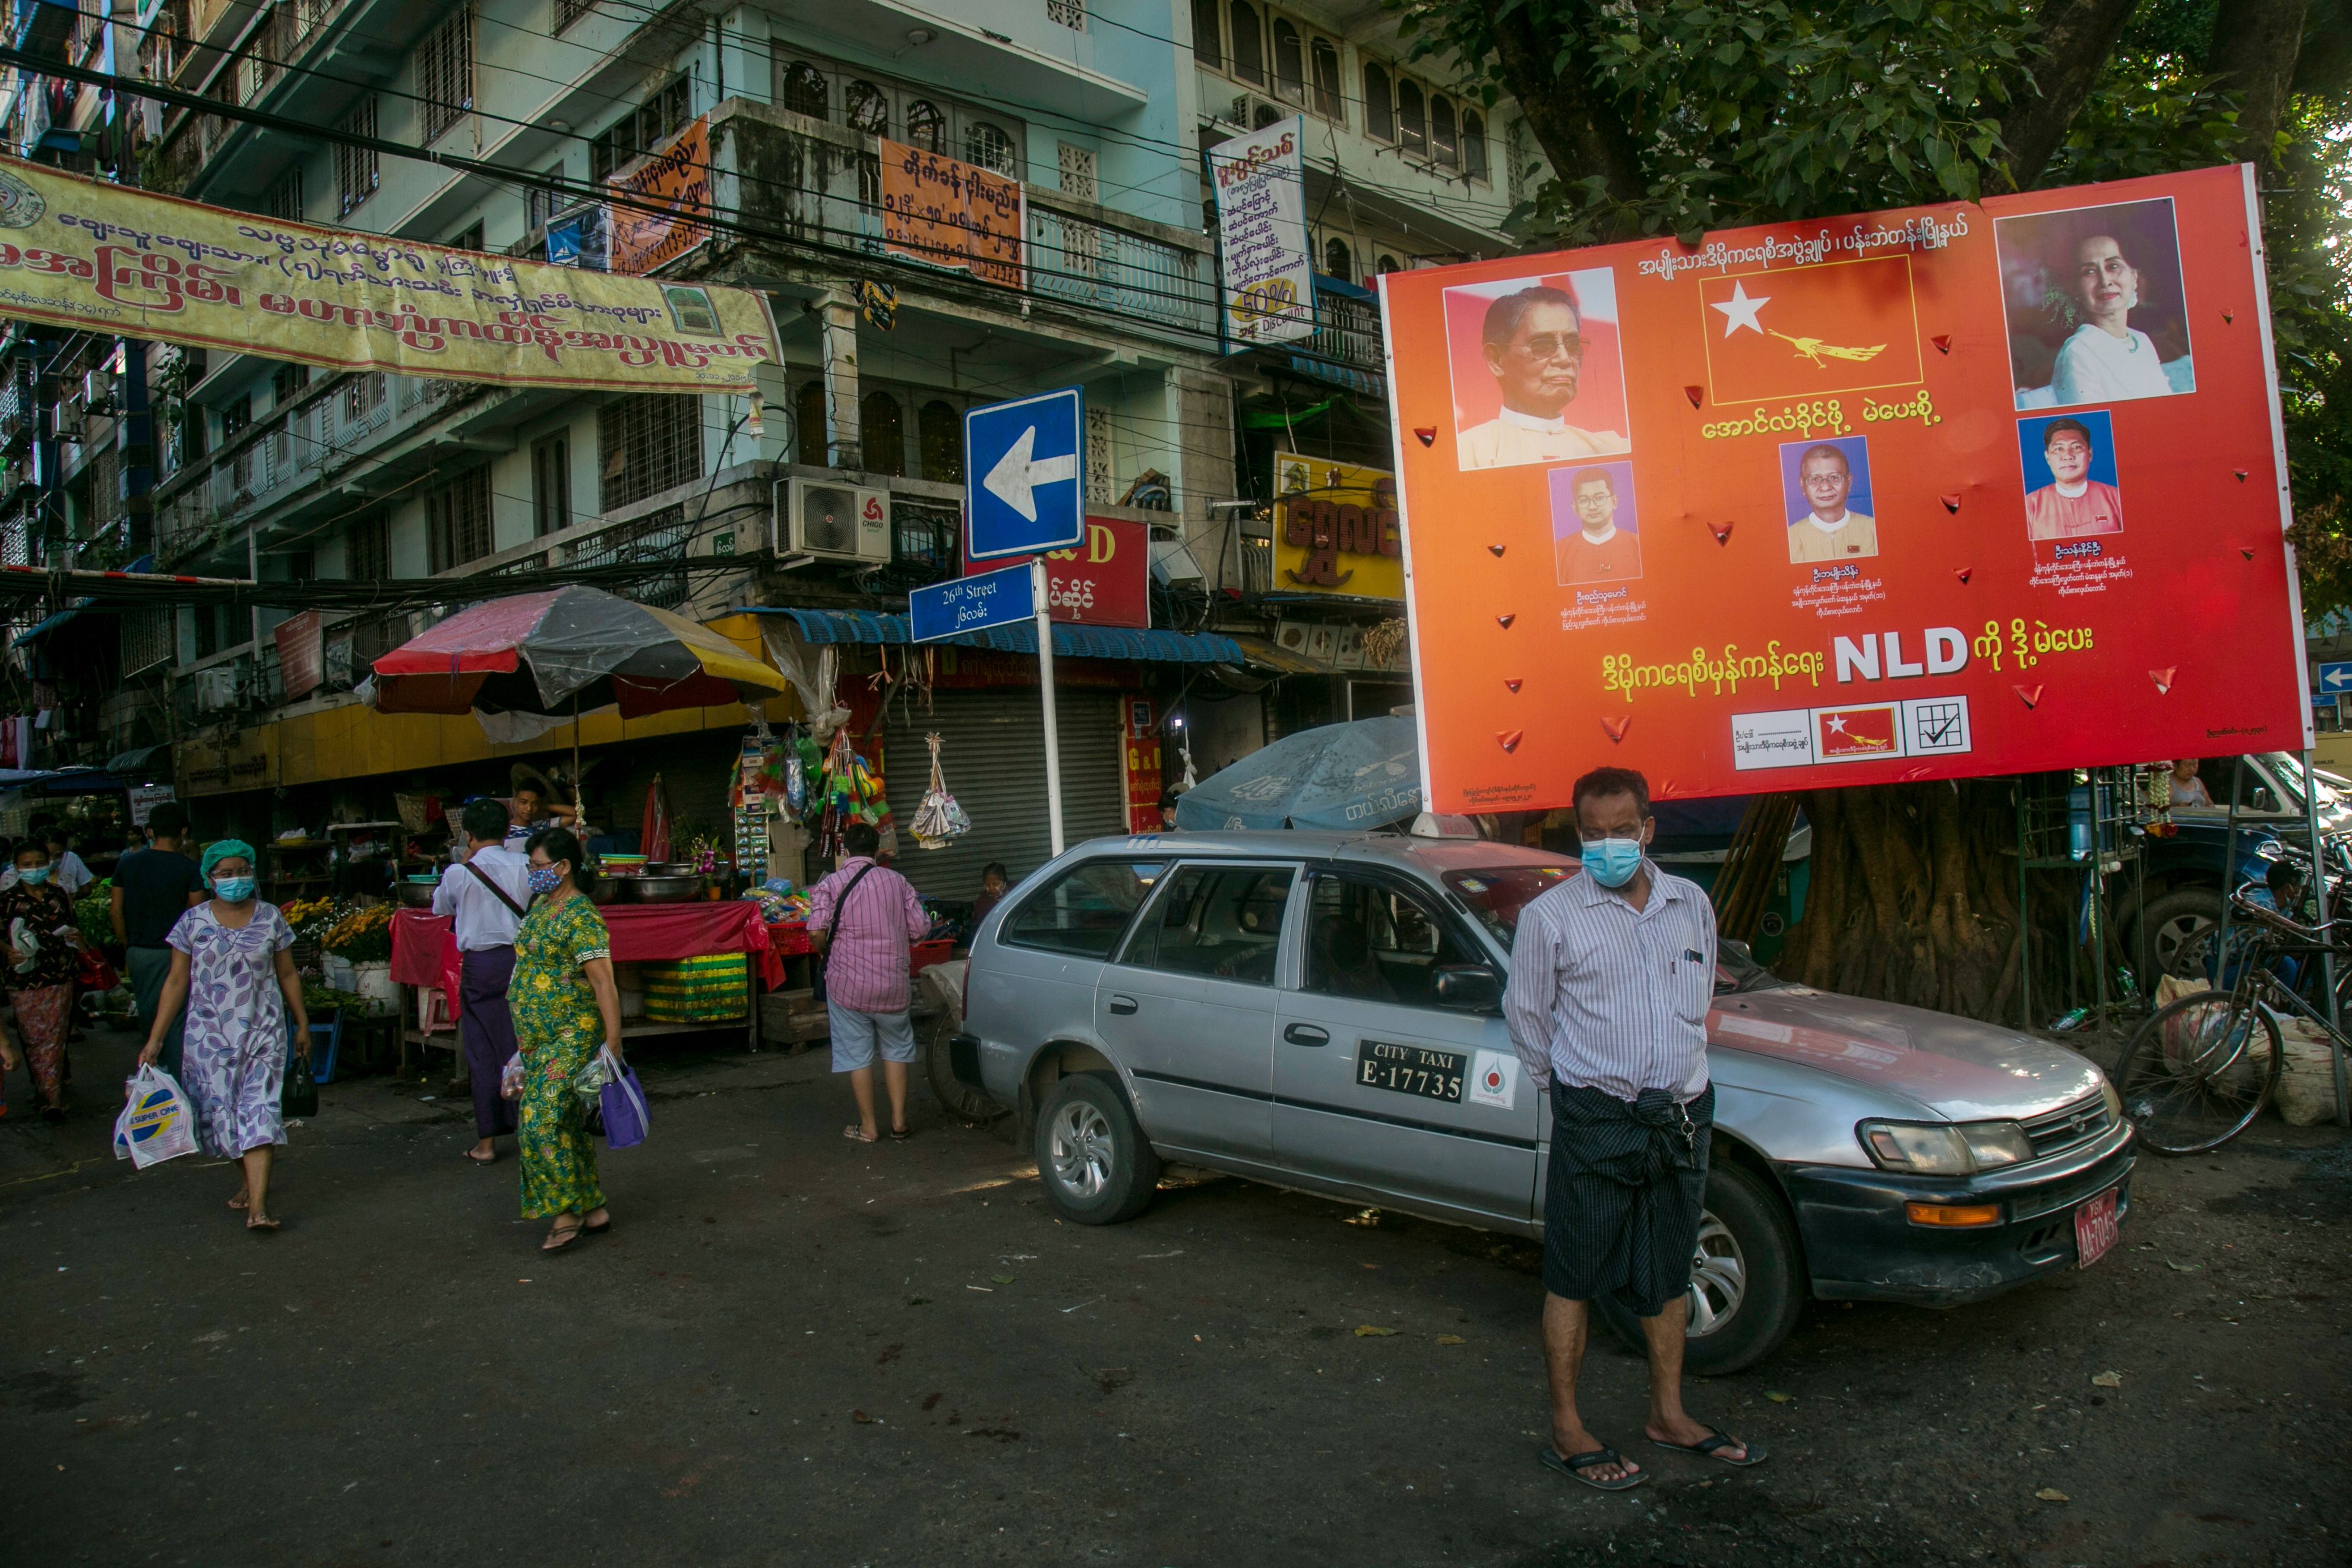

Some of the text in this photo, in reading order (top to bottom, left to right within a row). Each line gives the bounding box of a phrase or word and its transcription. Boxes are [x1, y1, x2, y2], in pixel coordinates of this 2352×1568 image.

[1243, 280, 1292, 319] 50%
[1263, 306, 1305, 331] Discount
[1702, 390, 1942, 439] အောင်လံခိုင်ဖို့ မဲပေးစို့
[862, 520, 883, 529] CHIGO
[943, 581, 997, 605] 26th Street
[1602, 640, 1824, 703] ဒီမိုကရေစီမှန်ကန်ရေး
[1833, 627, 1969, 682] NLD
[1974, 621, 2003, 671] ကို
[1374, 1044, 1454, 1069] CITY TAXI
[1361, 1060, 1462, 1099] E-17735
[135, 1104, 179, 1123] SUPER ONE
[2089, 1200, 2103, 1218] YGN
